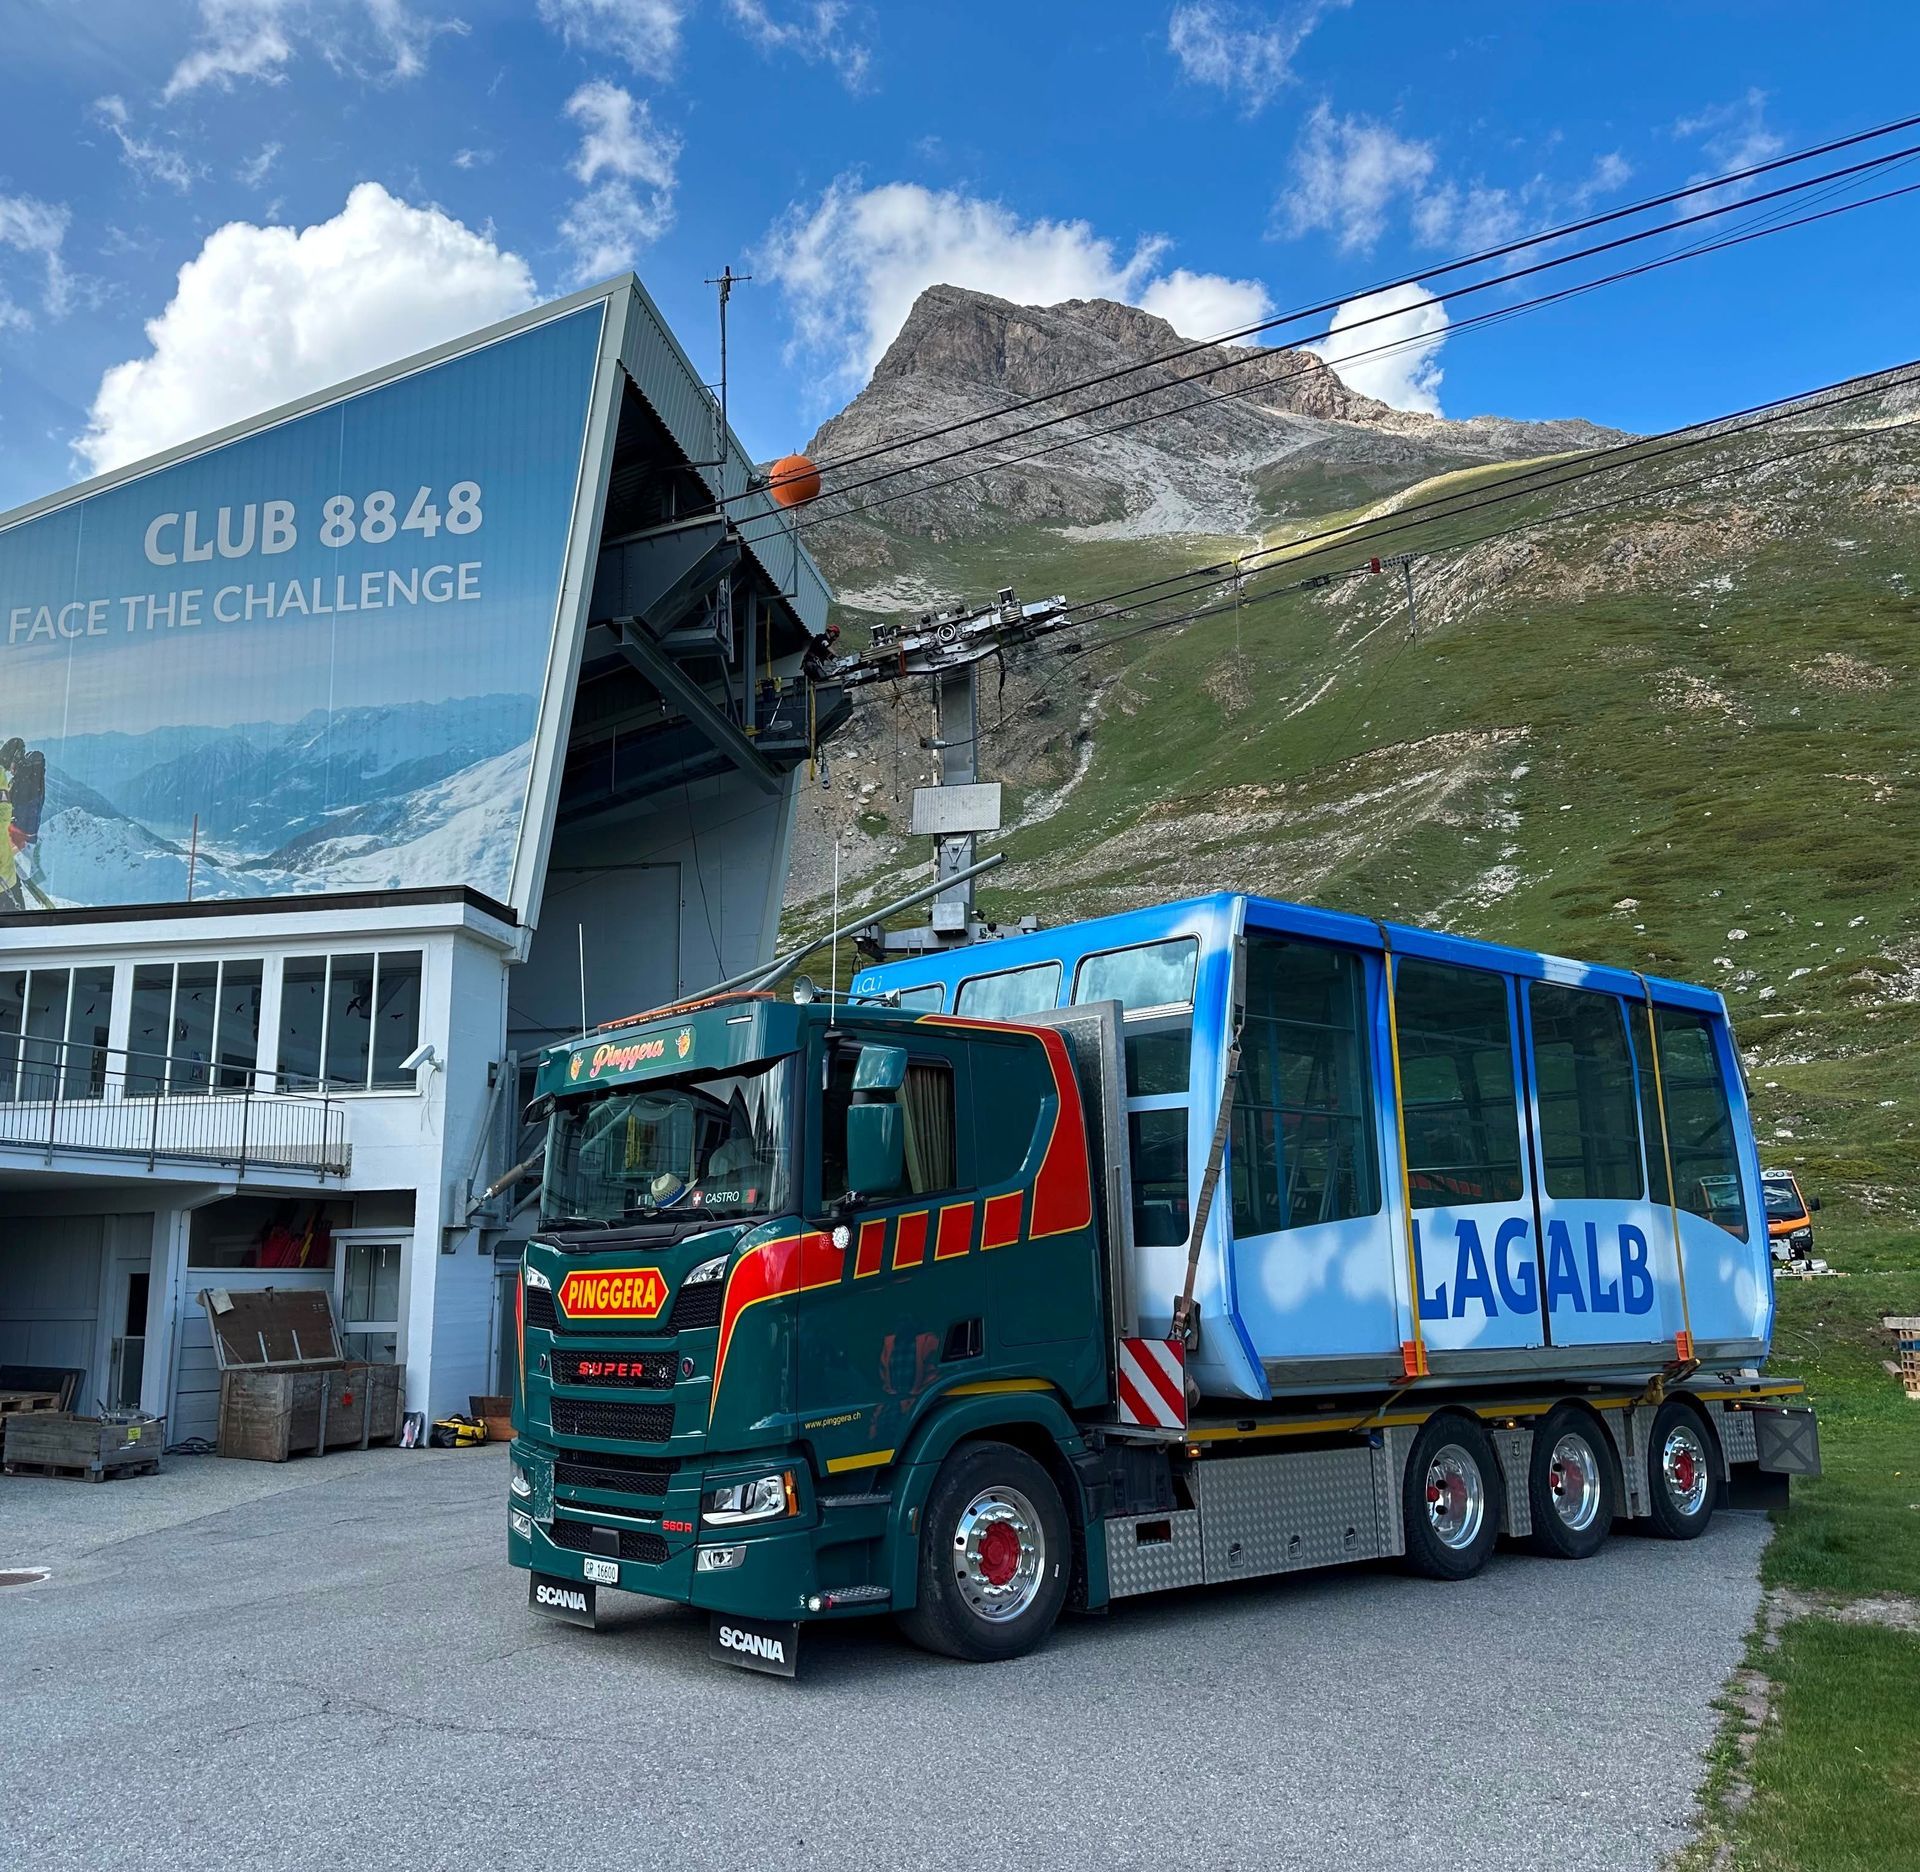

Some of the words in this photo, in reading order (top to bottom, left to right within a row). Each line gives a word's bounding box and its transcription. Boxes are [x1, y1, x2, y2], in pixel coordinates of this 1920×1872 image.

[144, 500, 298, 566] CLUB
[319, 480, 483, 548] 8848
[8, 599, 111, 644] FACE
[120, 589, 203, 632] THE
[212, 561, 482, 623] CHALLENGE
[589, 1038, 665, 1078] Pinggera
[705, 1190, 740, 1204] CASTRO
[1411, 1217, 1654, 1320] LAGALB
[567, 1277, 657, 1310] PINGGERA
[579, 1361, 644, 1377] SUPER
[804, 1411, 862, 1430] www.pinggera.ch
[536, 1585, 587, 1612] SCANIA
[719, 1626, 785, 1664] SCANIA
